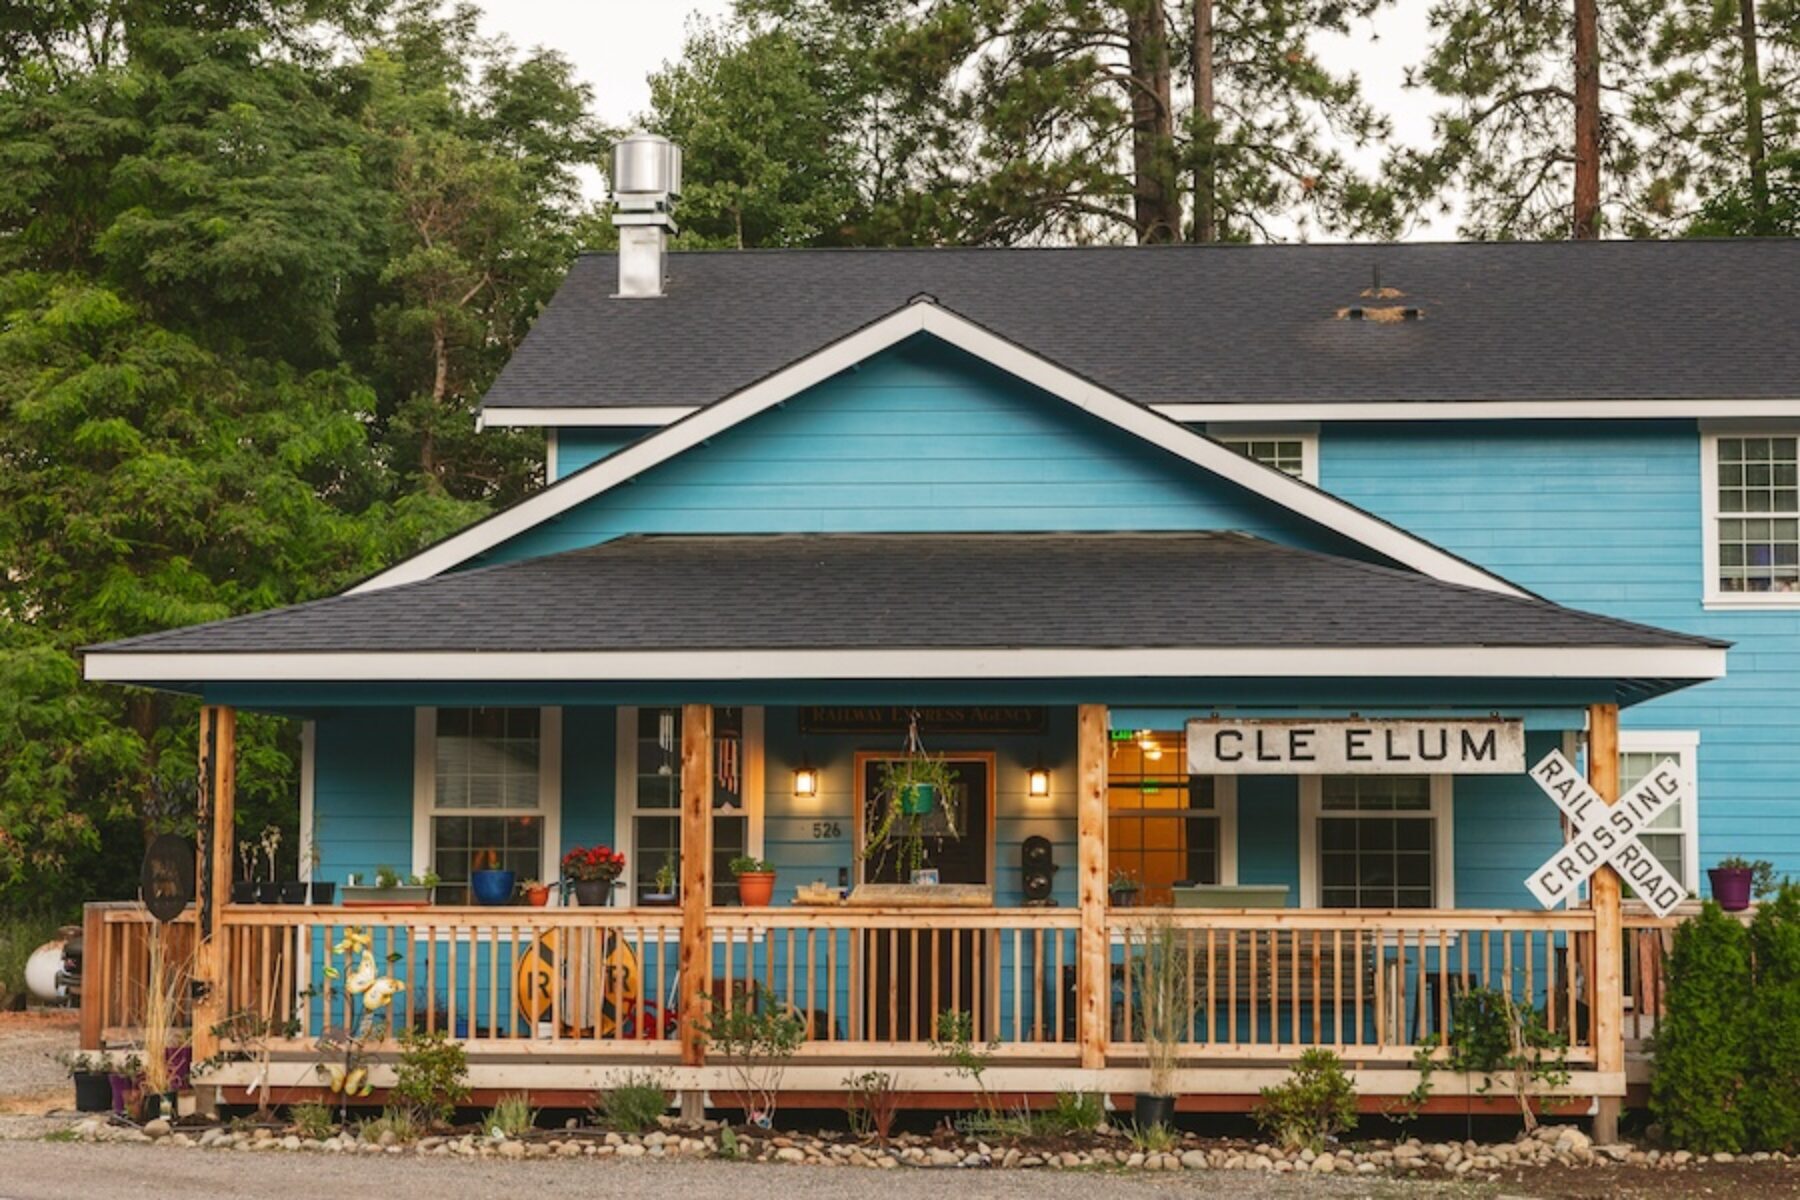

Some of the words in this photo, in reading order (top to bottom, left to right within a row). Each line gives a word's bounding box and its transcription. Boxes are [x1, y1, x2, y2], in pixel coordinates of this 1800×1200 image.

[1213, 729, 1316, 762] CLE
[1346, 729, 1498, 762] ELUM
[1539, 757, 1593, 823] RAIL
[812, 822, 842, 838] 526
[1538, 771, 1680, 897] CROSSING
[1616, 844, 1679, 910] ROAD
